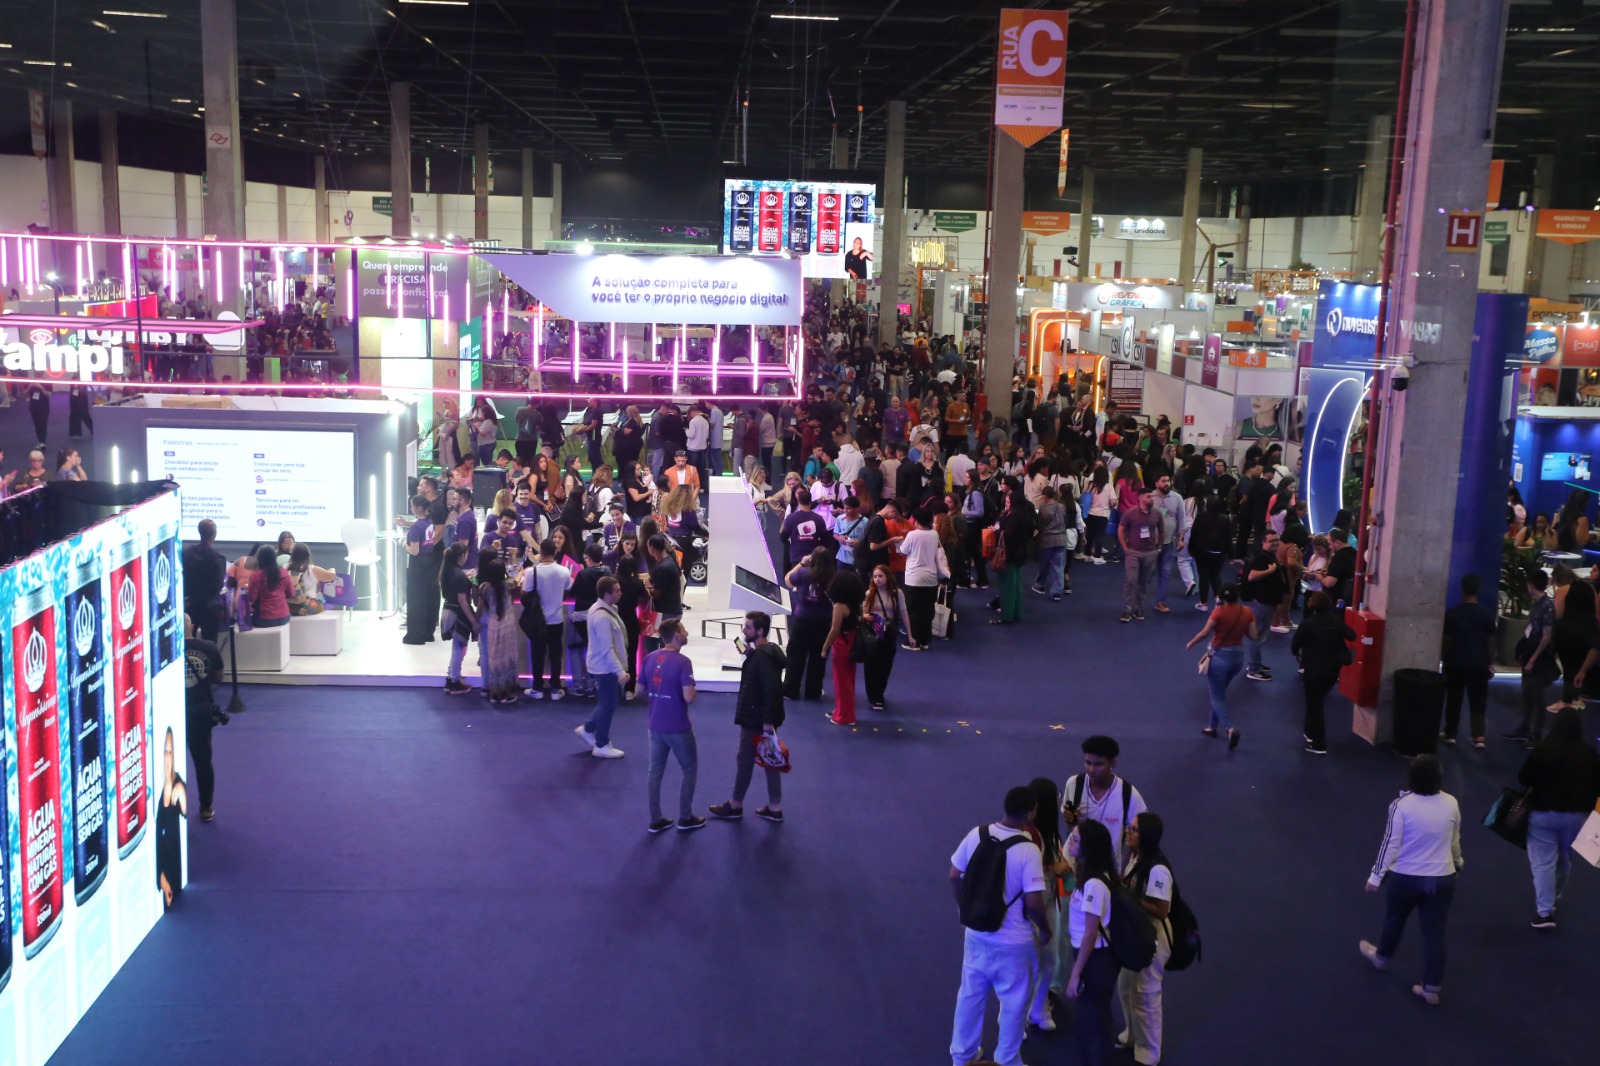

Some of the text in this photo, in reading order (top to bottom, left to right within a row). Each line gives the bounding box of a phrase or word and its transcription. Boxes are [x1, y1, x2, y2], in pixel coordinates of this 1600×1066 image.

[1001, 19, 1064, 77] RUA C
[1451, 218, 1476, 245] H
[393, 262, 448, 273] emprende
[363, 288, 395, 296] passr
[591, 276, 738, 290] A solução completa para
[591, 291, 788, 307] você ter o próprio negócio digital
[1524, 337, 1556, 349] Massa
[1529, 345, 1557, 358] Palha
[1244, 353, 1259, 366] 43
[120, 723, 142, 760] ÁGUA
[120, 744, 143, 776] MINERAL
[77, 755, 102, 797] ÁGUA
[120, 760, 143, 790] NATURAL
[77, 779, 103, 814] MINERAL
[26, 799, 56, 843] ÁGUA
[77, 795, 103, 830] NATURAL
[27, 823, 57, 861] MINERAL
[78, 821, 92, 845] SEM
[27, 843, 57, 880] NATURAL
[28, 866, 44, 895] COM
